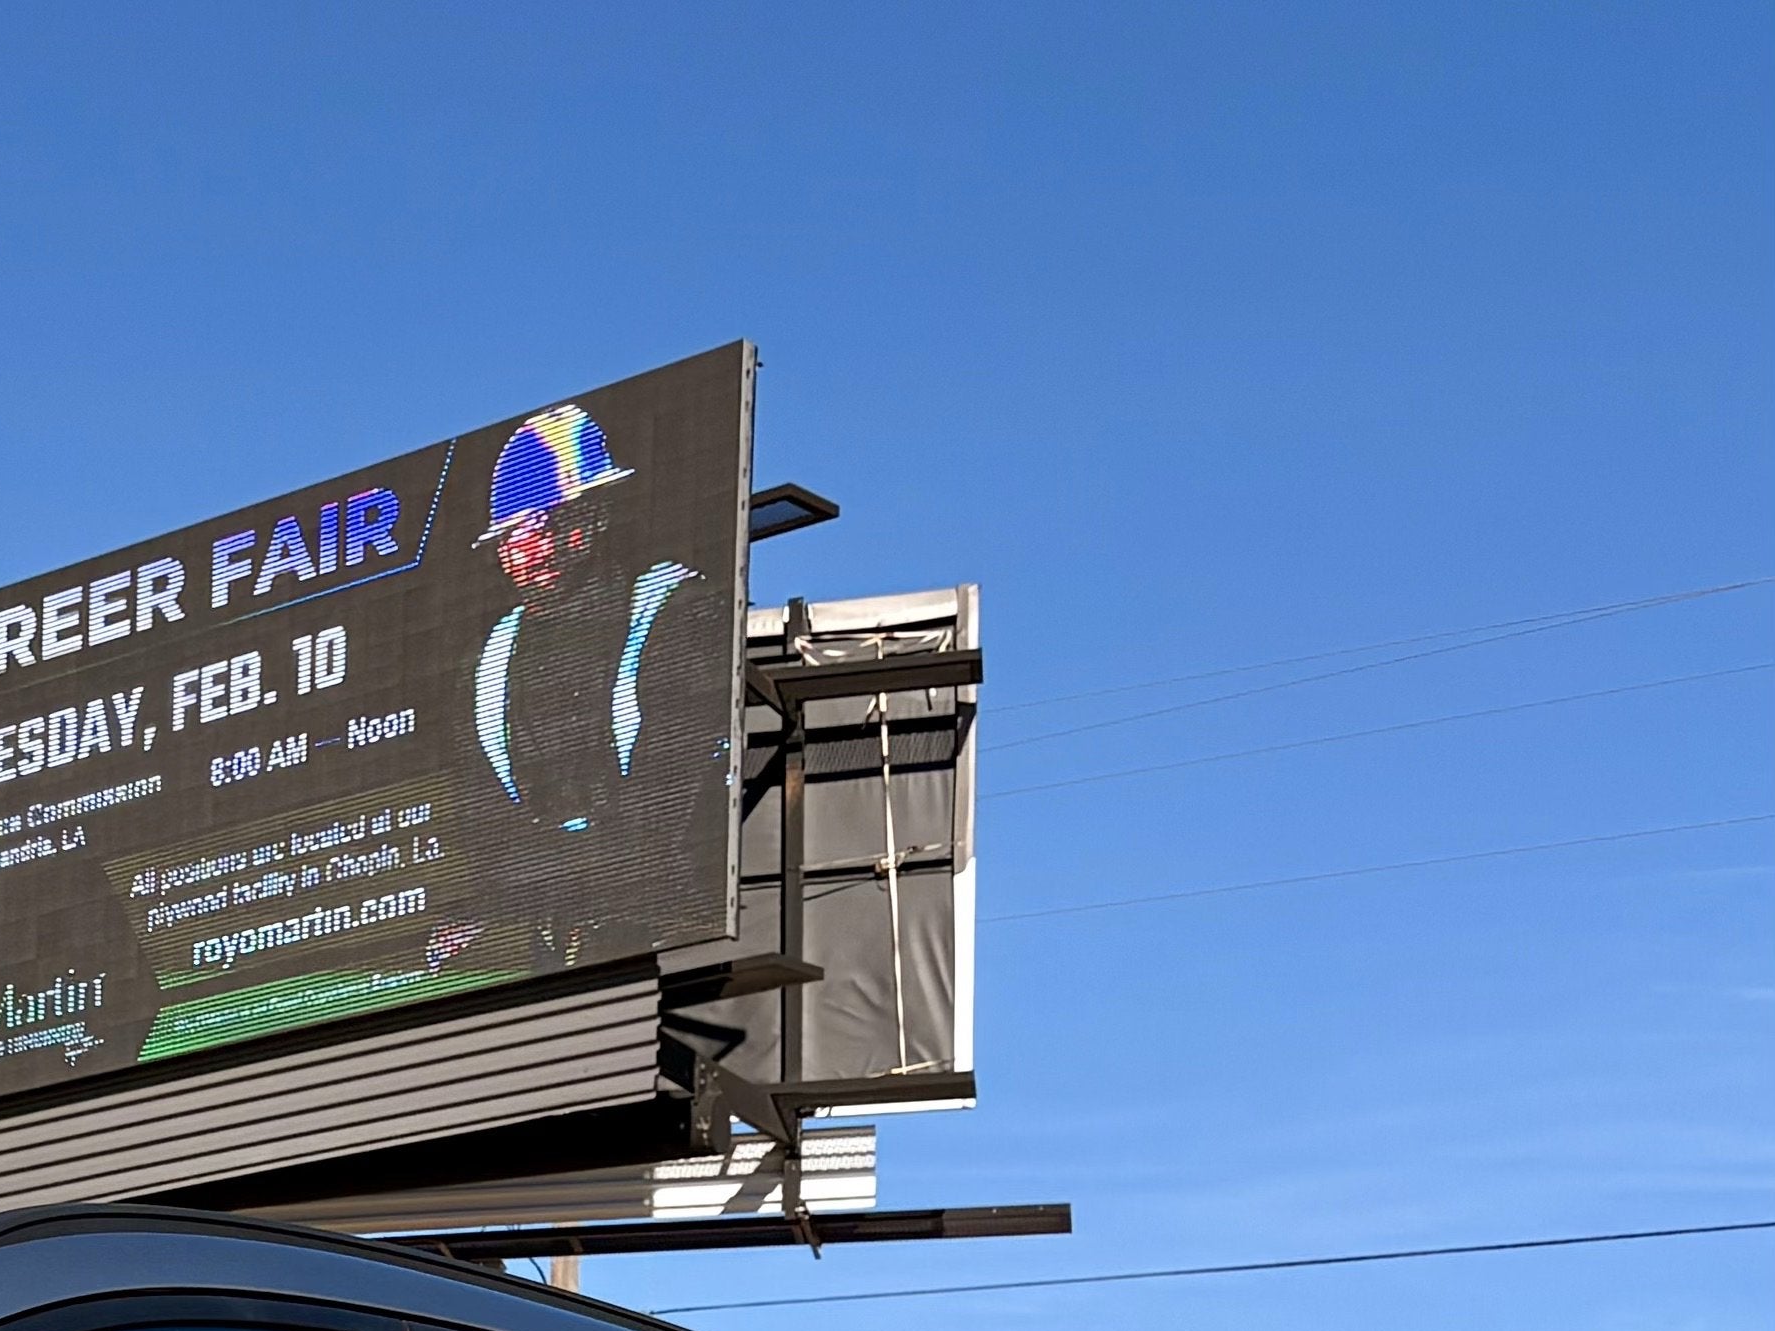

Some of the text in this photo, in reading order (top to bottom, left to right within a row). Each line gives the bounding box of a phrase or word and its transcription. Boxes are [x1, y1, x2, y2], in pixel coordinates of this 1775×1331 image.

[211, 487, 400, 609] FAIR
[172, 651, 278, 731] FEB.
[292, 625, 346, 695] 10
[266, 733, 308, 772] AM
[347, 708, 416, 749] Noon
[27, 775, 162, 828] Commission
[60, 826, 86, 850] LA
[130, 866, 156, 898] All
[160, 858, 247, 895] positions
[290, 814, 366, 856] located
[371, 808, 391, 835] at
[397, 802, 431, 828] our
[232, 870, 297, 904] facility
[301, 864, 320, 889] in
[193, 886, 427, 969] royomartin.com
